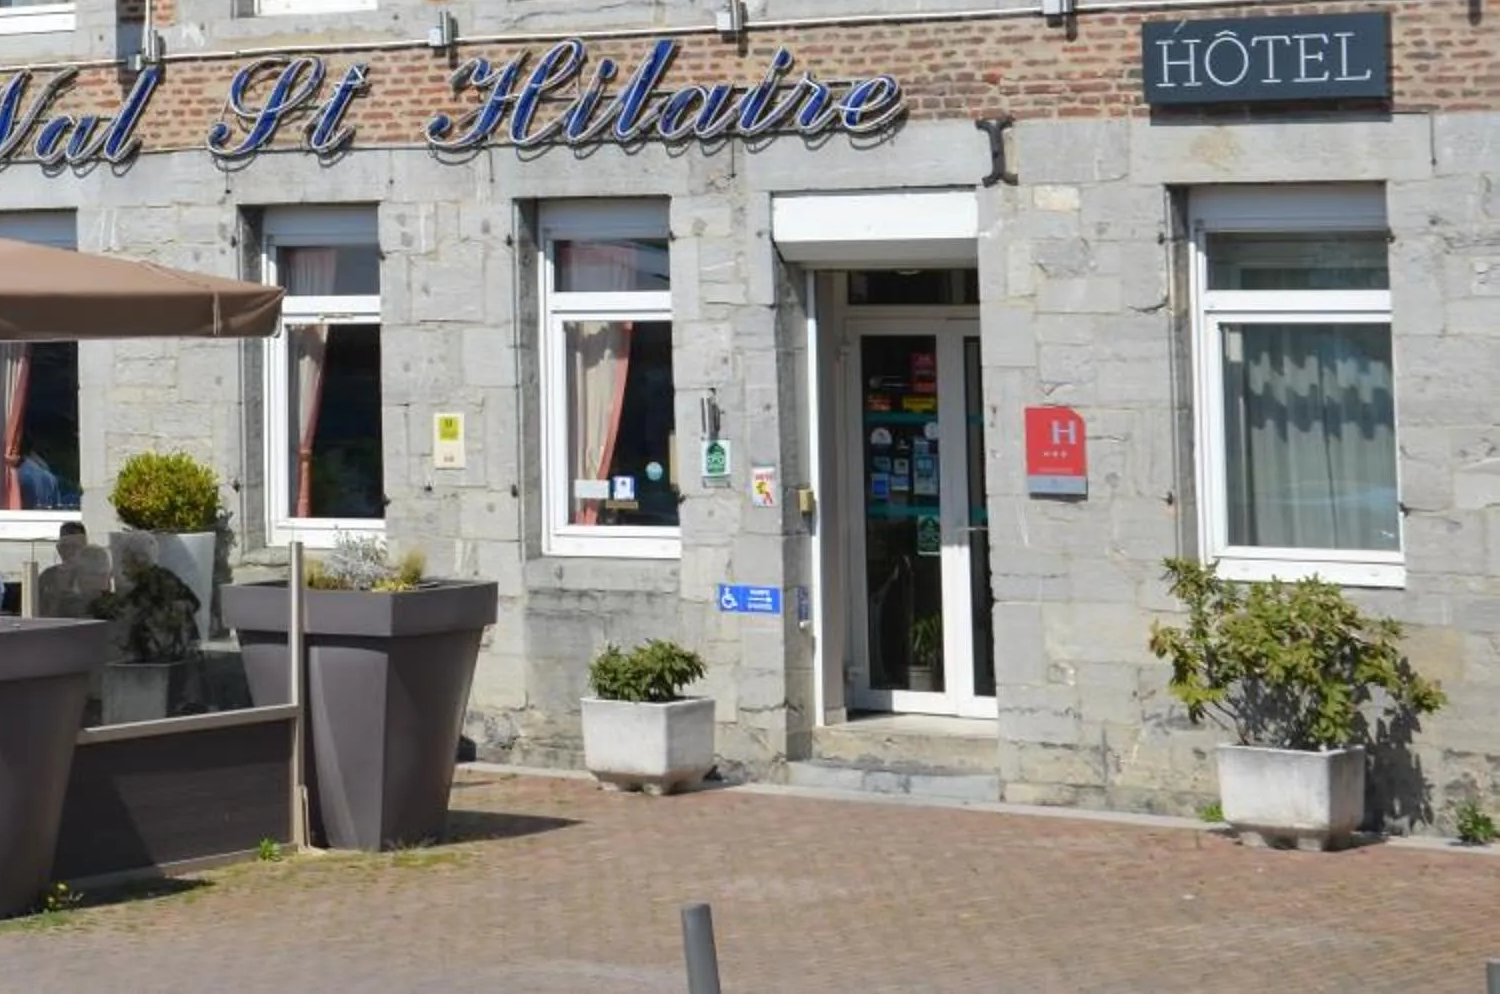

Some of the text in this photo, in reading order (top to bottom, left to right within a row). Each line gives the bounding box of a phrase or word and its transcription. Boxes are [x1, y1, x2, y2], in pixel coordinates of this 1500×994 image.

[1155, 29, 1372, 88] HÔTEL
[207, 55, 371, 155] St
[425, 37, 903, 147] Hilaire
[1051, 419, 1077, 445] H
